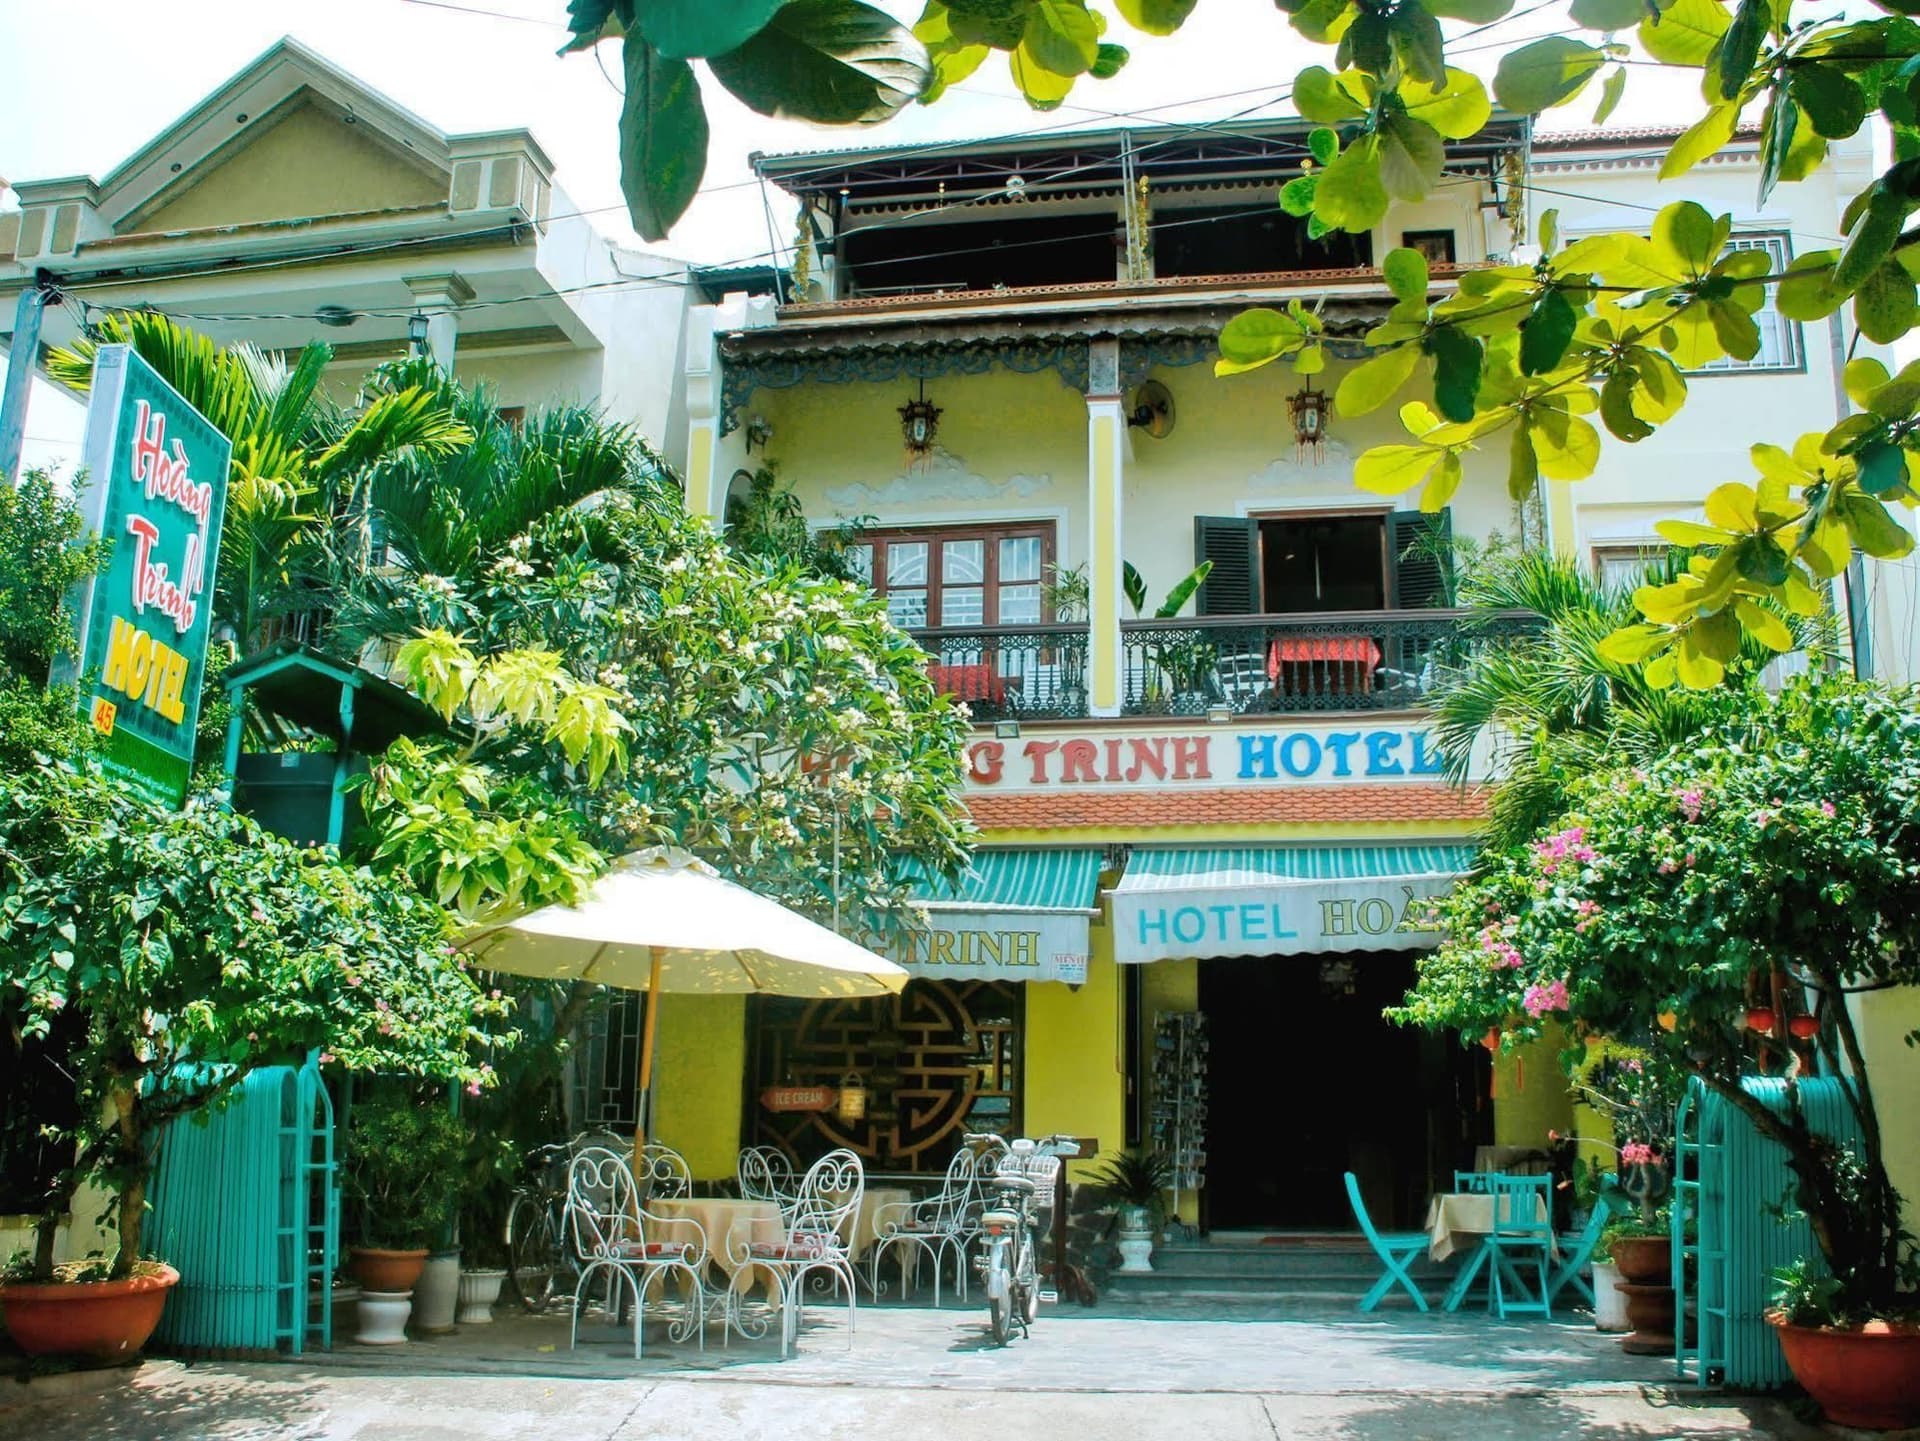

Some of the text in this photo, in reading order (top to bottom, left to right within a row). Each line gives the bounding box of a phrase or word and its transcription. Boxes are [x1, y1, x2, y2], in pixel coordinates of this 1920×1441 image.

[131, 400, 212, 594] Hoàng
[126, 514, 197, 633] Trinh
[102, 615, 189, 725] HOTEL
[97, 702, 114, 731] 45
[1023, 735, 1212, 784] TRINH
[1236, 731, 1446, 779] HOTEL
[898, 929, 1041, 967] TRINH
[1138, 904, 1298, 945] HOTEL
[792, 1090, 824, 1105] CREAM
